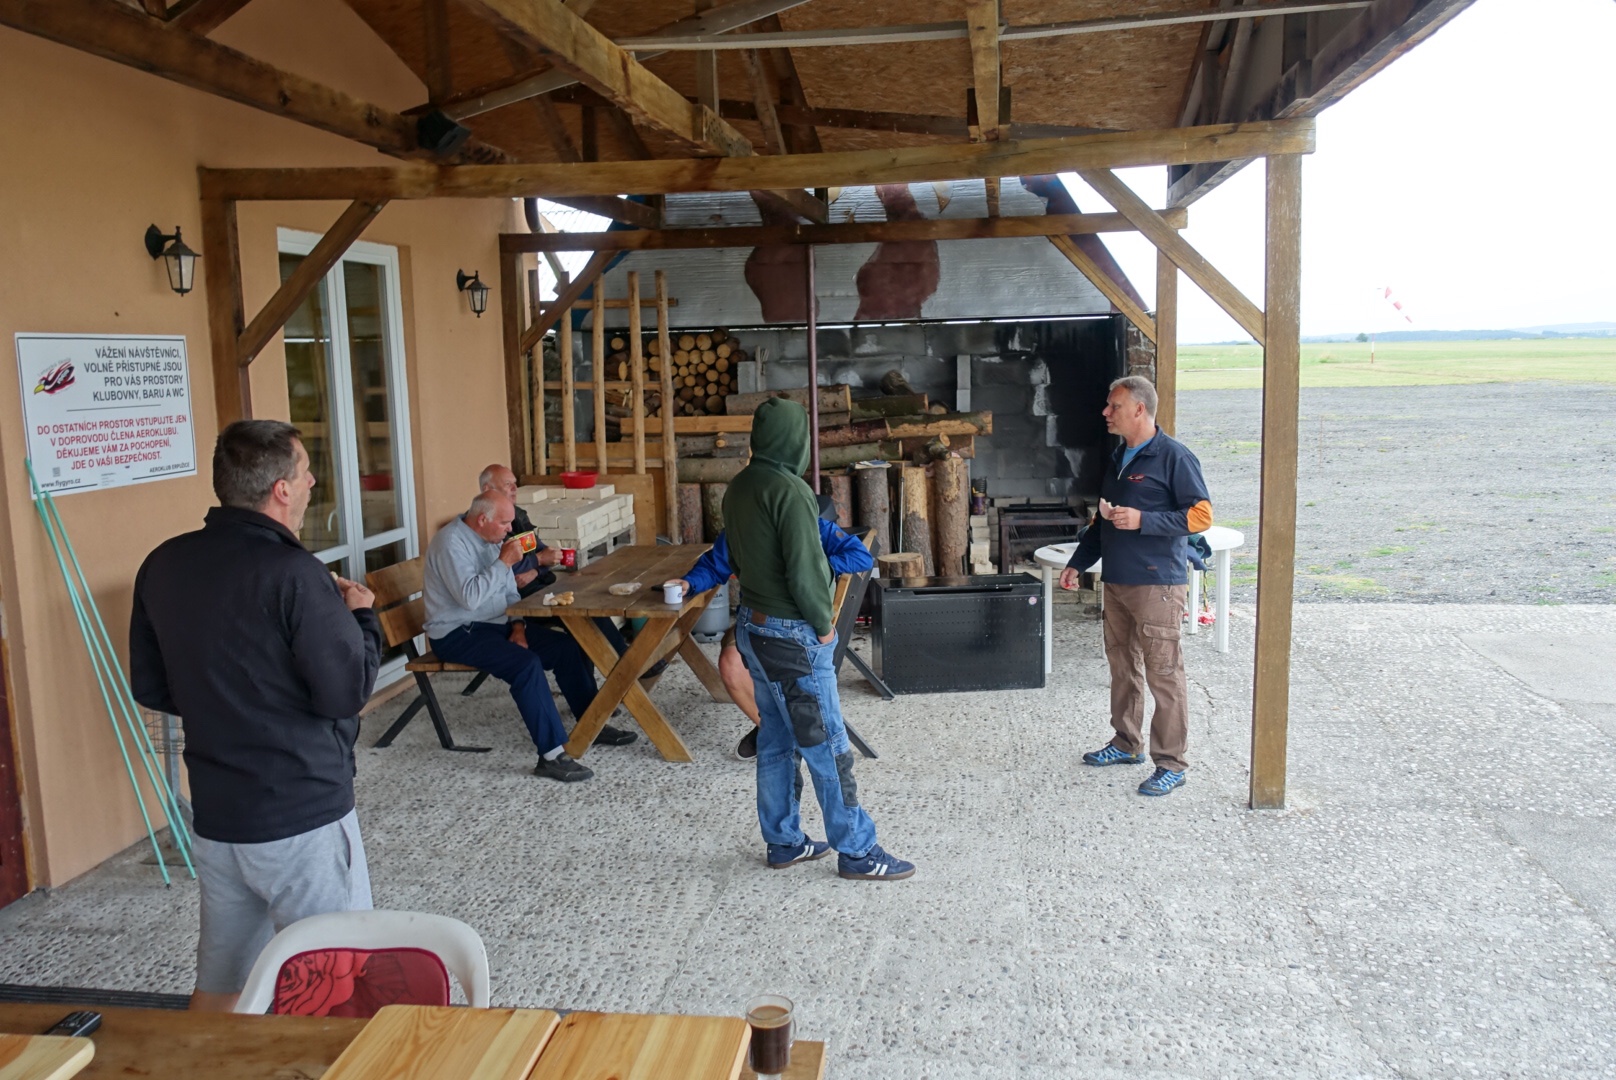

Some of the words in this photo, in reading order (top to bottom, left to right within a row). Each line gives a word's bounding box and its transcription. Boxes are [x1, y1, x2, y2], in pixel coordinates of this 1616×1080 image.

[95, 346, 127, 358] VÁŽENÍ
[128, 346, 181, 359] NÁVŠTĚVNÍCI,
[116, 360, 161, 373] PŘÍSTUPNÉ
[162, 361, 183, 372] JSOU
[104, 376, 123, 387] PRO
[124, 374, 141, 386] VÁS
[143, 374, 183, 385] PROSTORY
[93, 389, 141, 402] KLUBOVNY,
[142, 388, 164, 399] BARU
[166, 388, 171, 398] A
[172, 387, 184, 398] WC
[37, 425, 50, 435] DO
[52, 421, 97, 433] OSTATNÍCH
[99, 419, 135, 430] PROSTOR
[136, 415, 174, 426] VSTUPUJTE
[175, 414, 187, 424] JEN
[50, 437, 56, 447] V
[58, 432, 109, 447] DOPROVODU
[110, 430, 135, 441] ČLENA
[136, 427, 179, 438] AEROKLUBU.
[56, 446, 100, 459] DĚKUJEME
[101, 443, 118, 454] VÁM
[119, 443, 129, 452] ZA
[130, 437, 172, 451] POCHOPENÍ,
[71, 459, 87, 470] JDE
[88, 458, 95, 468] O
[96, 455, 113, 467] VAŠI
[114, 451, 162, 465] BEZPEČNOST.
[149, 464, 171, 473] AEROKLUB
[41, 478, 81, 488] www.flygyro.cz
